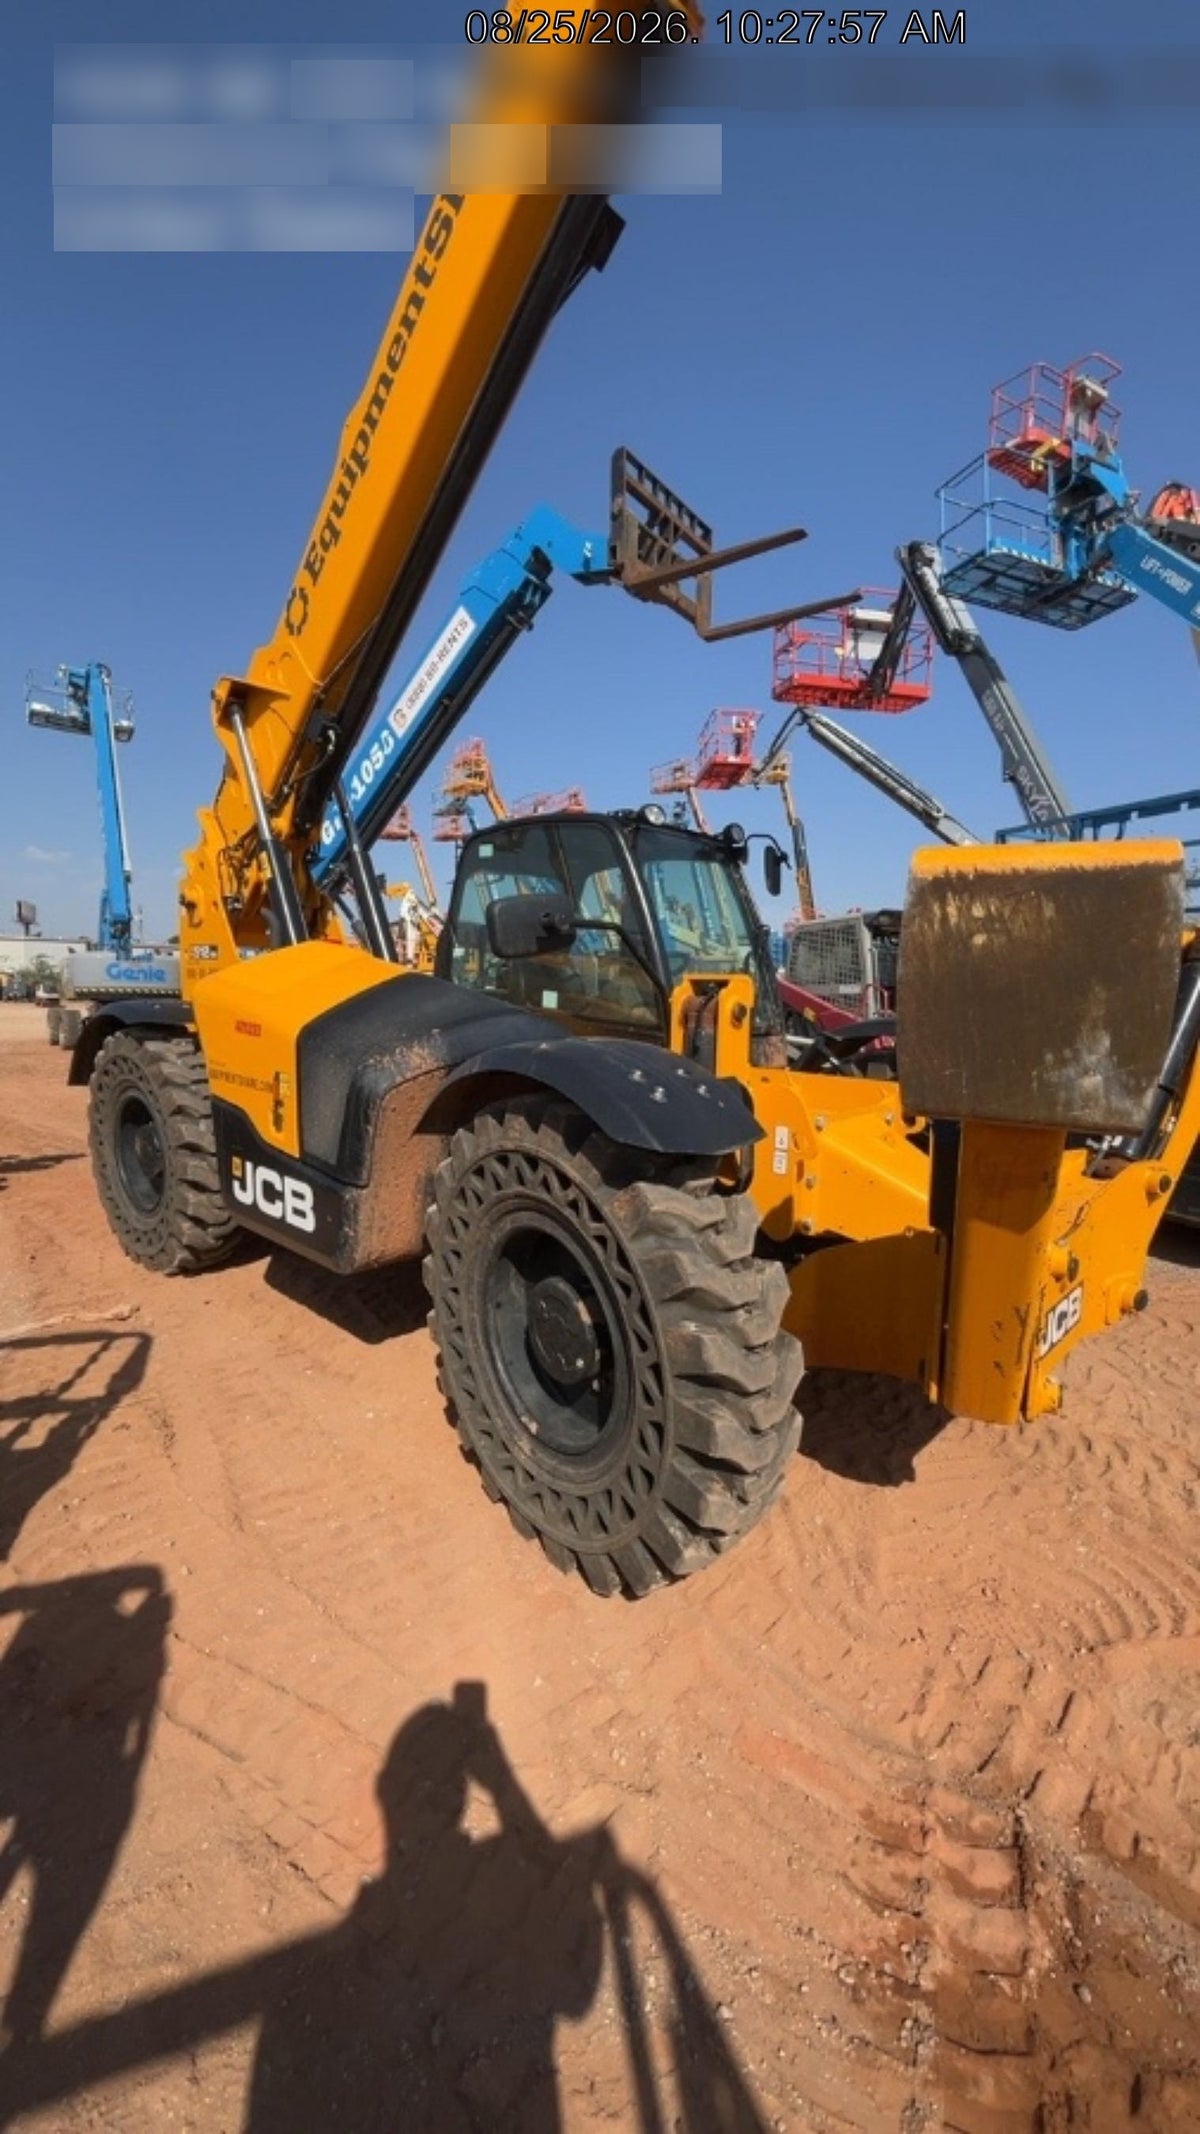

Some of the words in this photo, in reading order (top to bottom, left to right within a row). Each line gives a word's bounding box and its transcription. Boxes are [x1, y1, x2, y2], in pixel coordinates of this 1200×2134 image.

[106, 962, 167, 982] Genie
[231, 1155, 317, 1234] JCB
[1038, 1286, 1083, 1358] JCB
